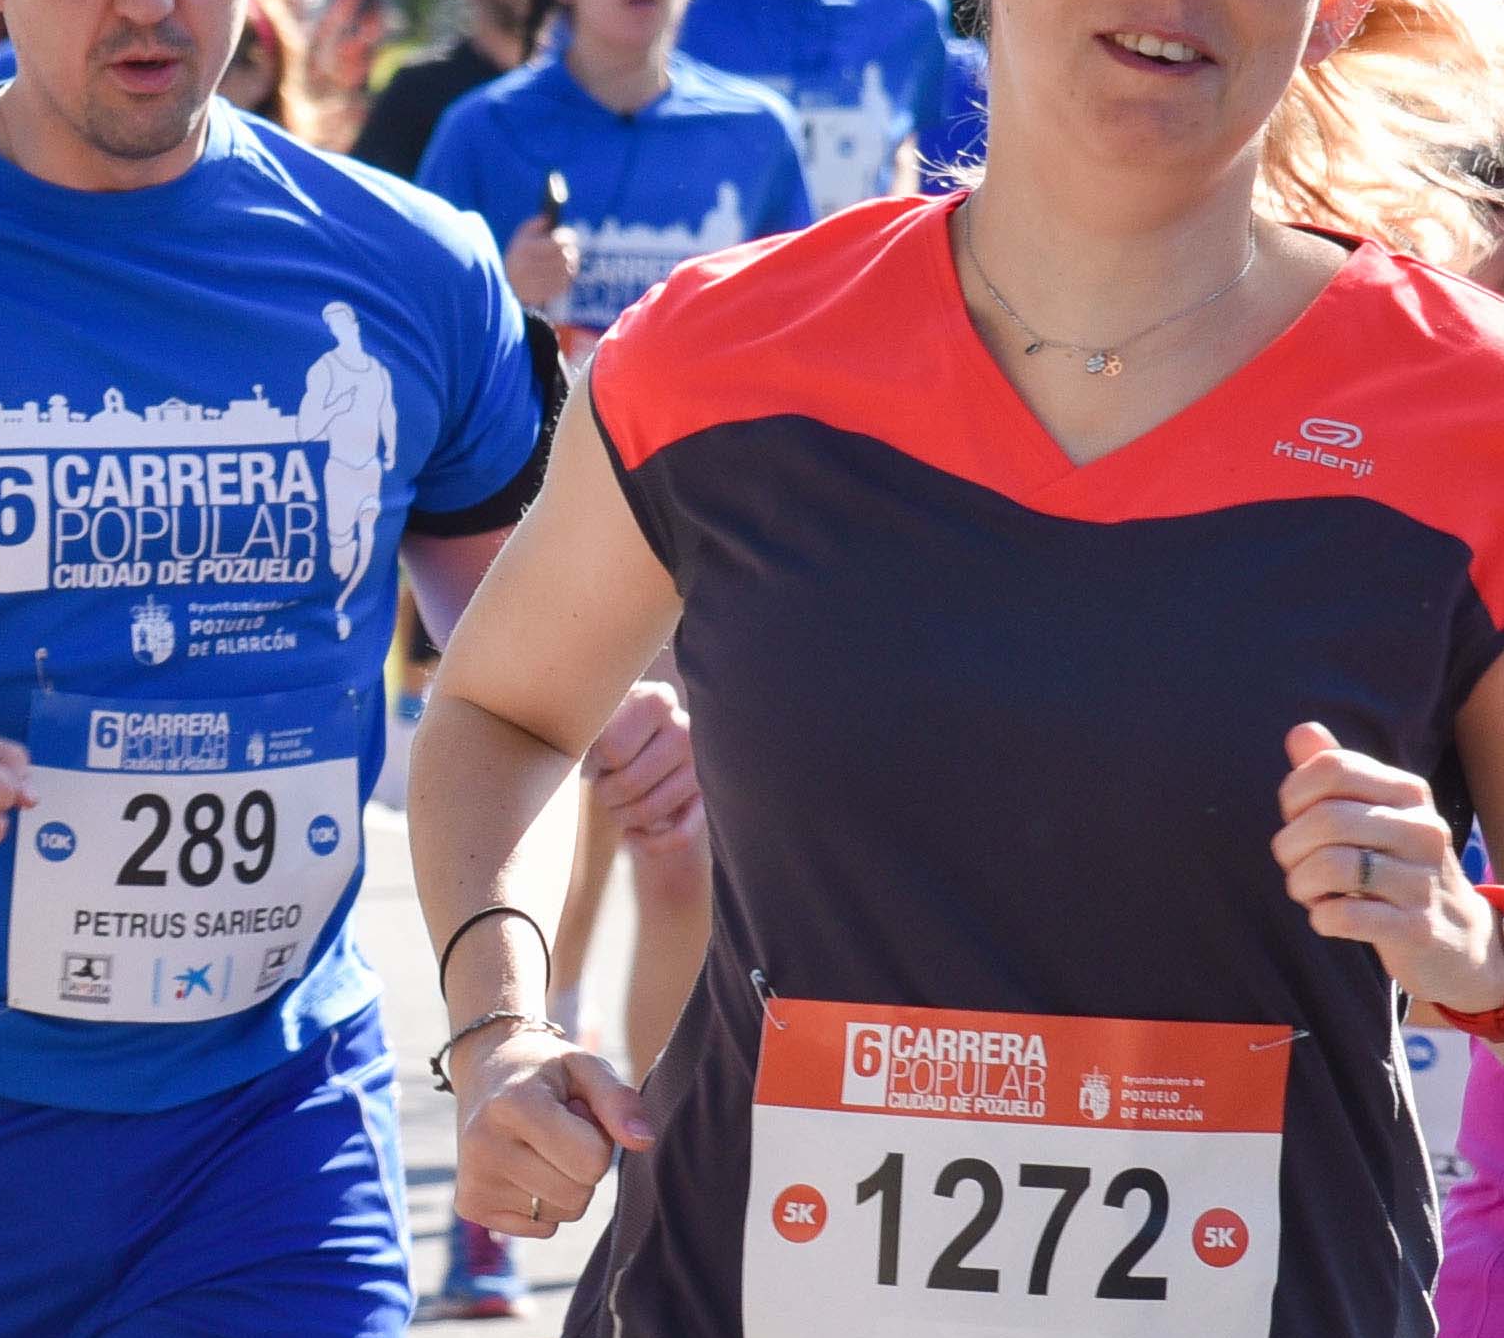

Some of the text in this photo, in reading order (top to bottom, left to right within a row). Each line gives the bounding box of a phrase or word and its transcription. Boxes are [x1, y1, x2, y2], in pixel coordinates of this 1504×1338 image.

[53, 450, 317, 508] CARRERA
[55, 503, 318, 563] POPULAR
[54, 557, 315, 589] CIUDAD DE POZUELO
[189, 615, 266, 636] POZUELO
[188, 627, 297, 657] DE ALARCÓN
[96, 716, 118, 749] 6
[125, 713, 229, 736] CARRERA
[125, 735, 228, 760] POPULAR
[116, 790, 276, 887] 289
[74, 904, 302, 939] PETRUS SARIEGO
[853, 1029, 882, 1078] 6
[892, 1025, 1048, 1067] CARRERA
[890, 1058, 1047, 1101] POPULAR
[888, 1092, 1045, 1118] CIUDAD DE POZUELO
[1120, 1103, 1203, 1122] DE ALARCÓN
[1121, 1089, 1180, 1104] POZUELO
[783, 1202, 817, 1225] 5K
[856, 1151, 1170, 1301] 1272
[1203, 1228, 1238, 1250] 5K
